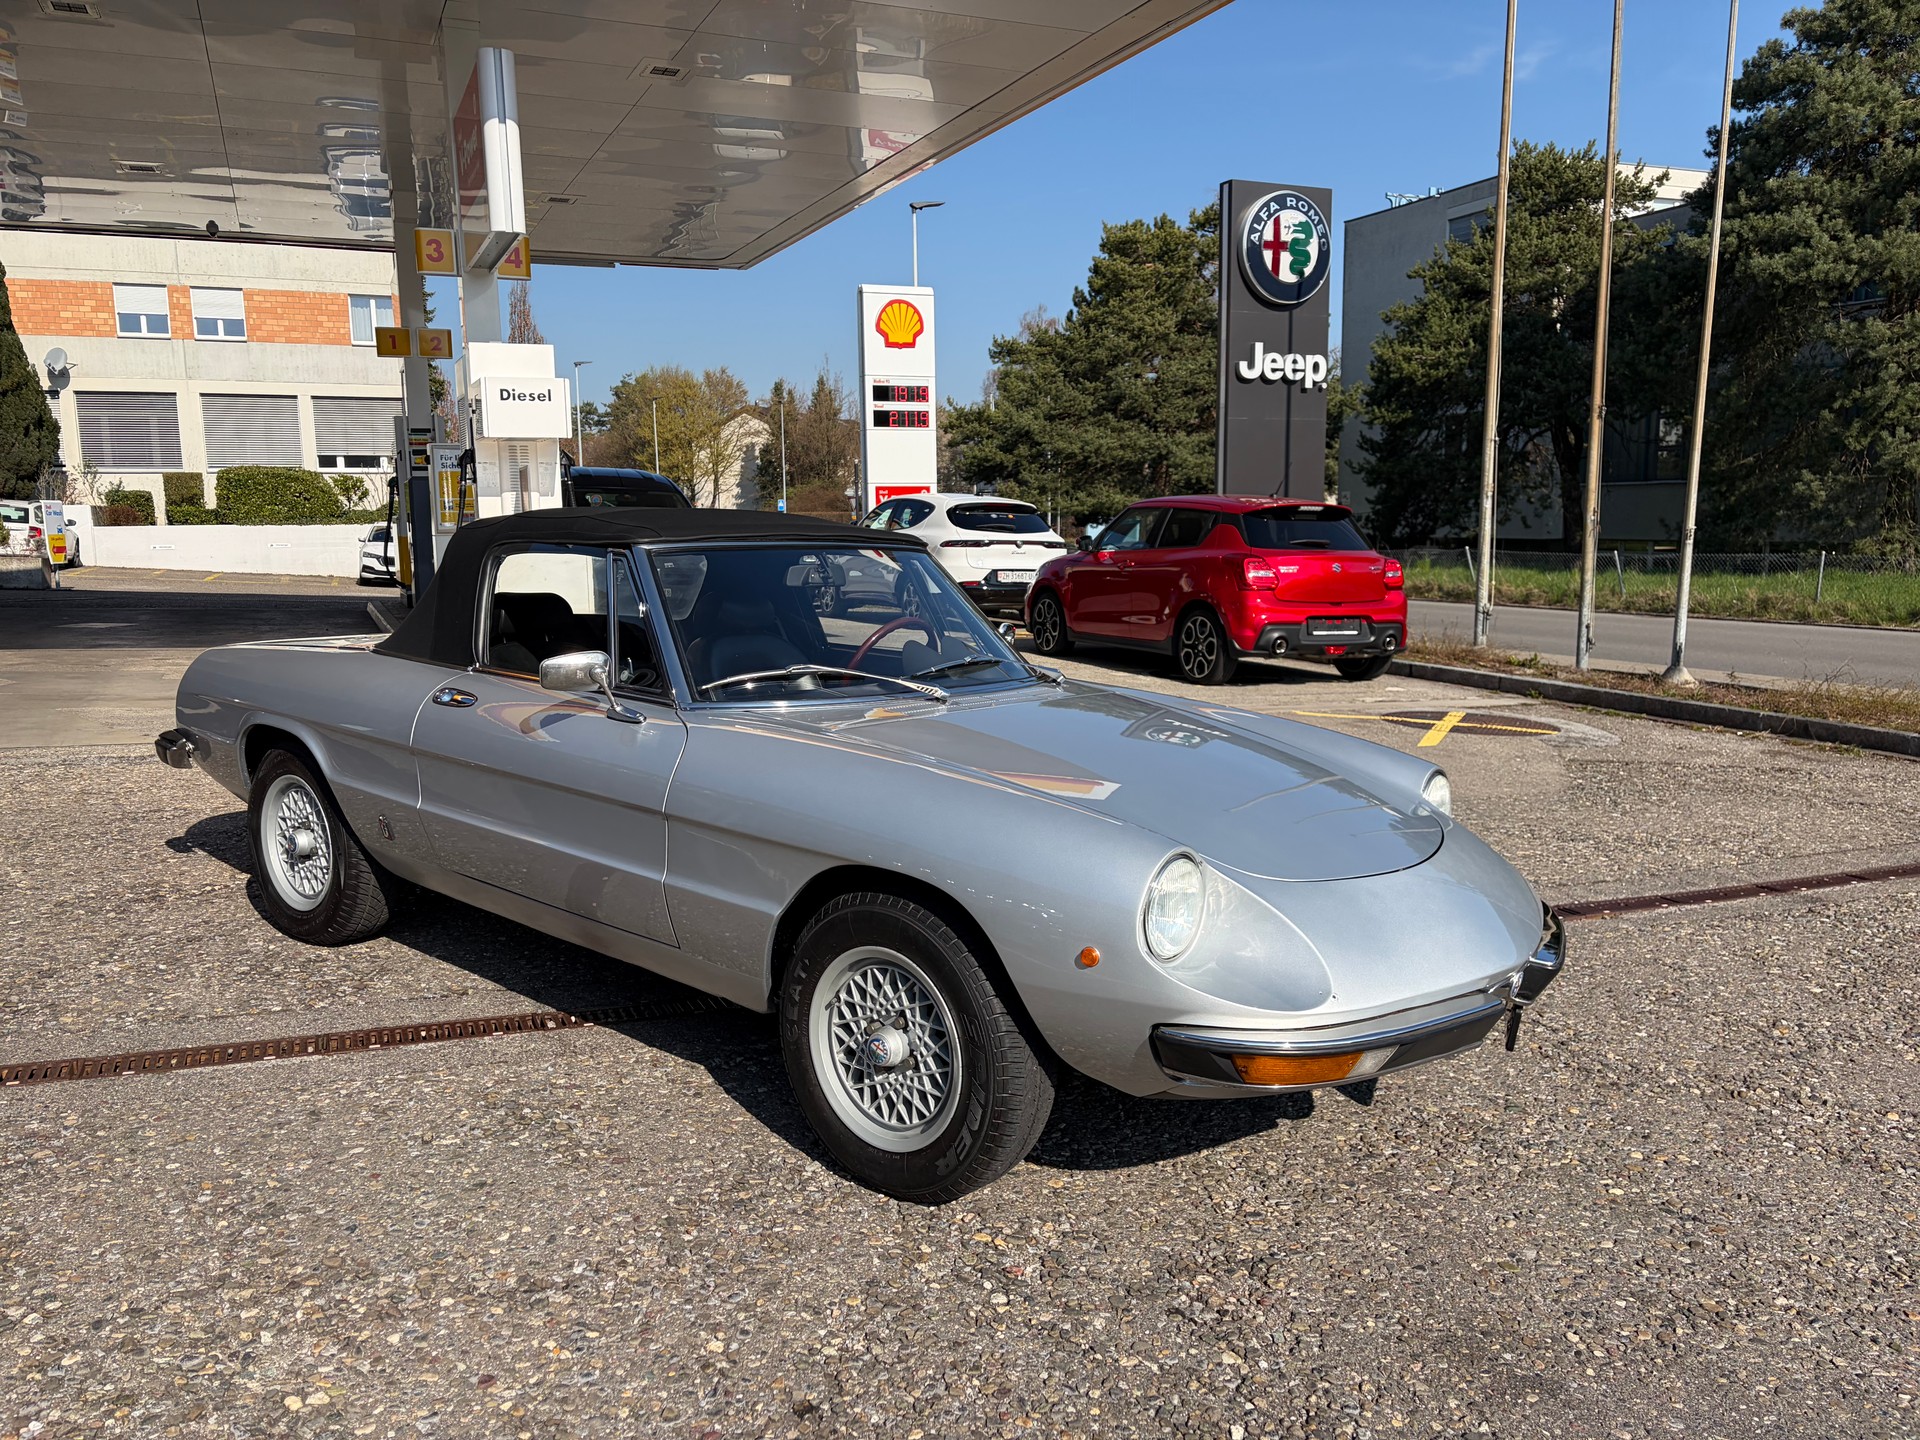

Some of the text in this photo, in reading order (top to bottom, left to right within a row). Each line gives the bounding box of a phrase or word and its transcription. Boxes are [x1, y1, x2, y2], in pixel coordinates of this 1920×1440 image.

[1250, 196, 1328, 251] ALFA ROMEO
[425, 238, 445, 263] 3
[504, 246, 523, 269] 4
[388, 334, 397, 350] 1
[430, 336, 442, 351] 2
[500, 388, 552, 402] Diesel
